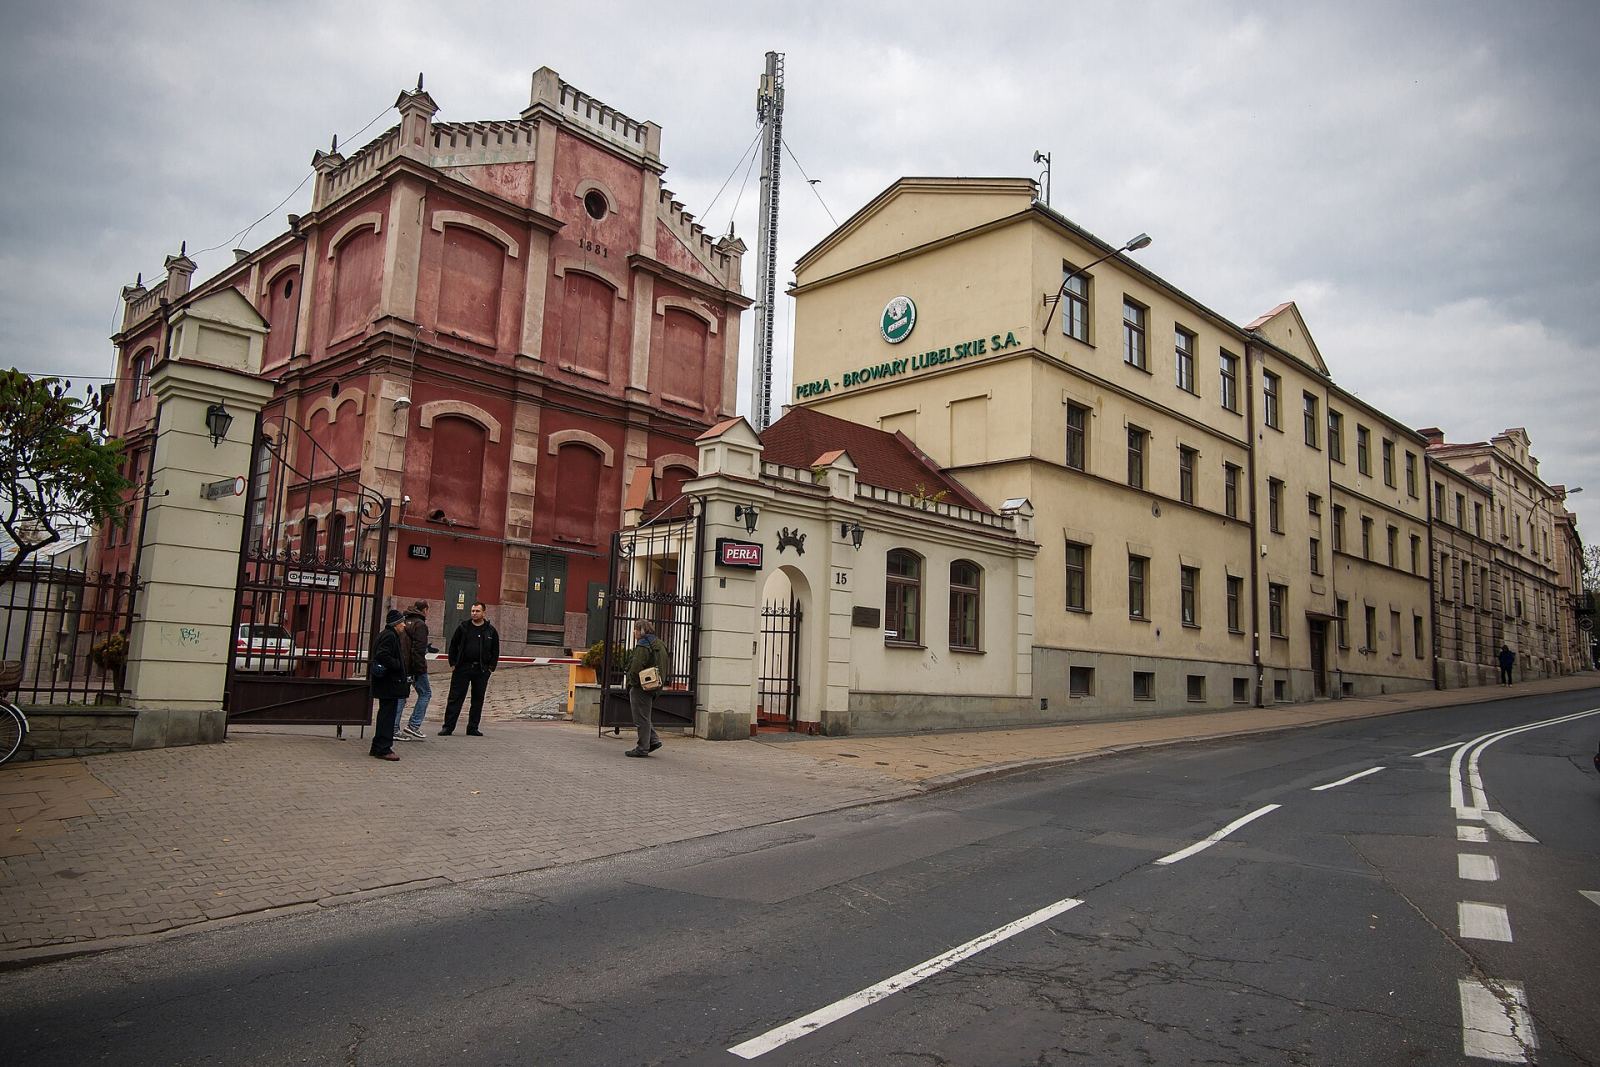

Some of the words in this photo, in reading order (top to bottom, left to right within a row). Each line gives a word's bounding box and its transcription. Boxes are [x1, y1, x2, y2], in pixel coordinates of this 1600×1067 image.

[579, 238, 608, 258] 1881
[795, 378, 831, 399] PERŁA
[843, 358, 910, 388] BROWARY
[911, 339, 987, 371] LUBELSKIE
[991, 331, 1021, 352] S.A.
[726, 548, 758, 560] PERŁA
[835, 572, 847, 585] 15
